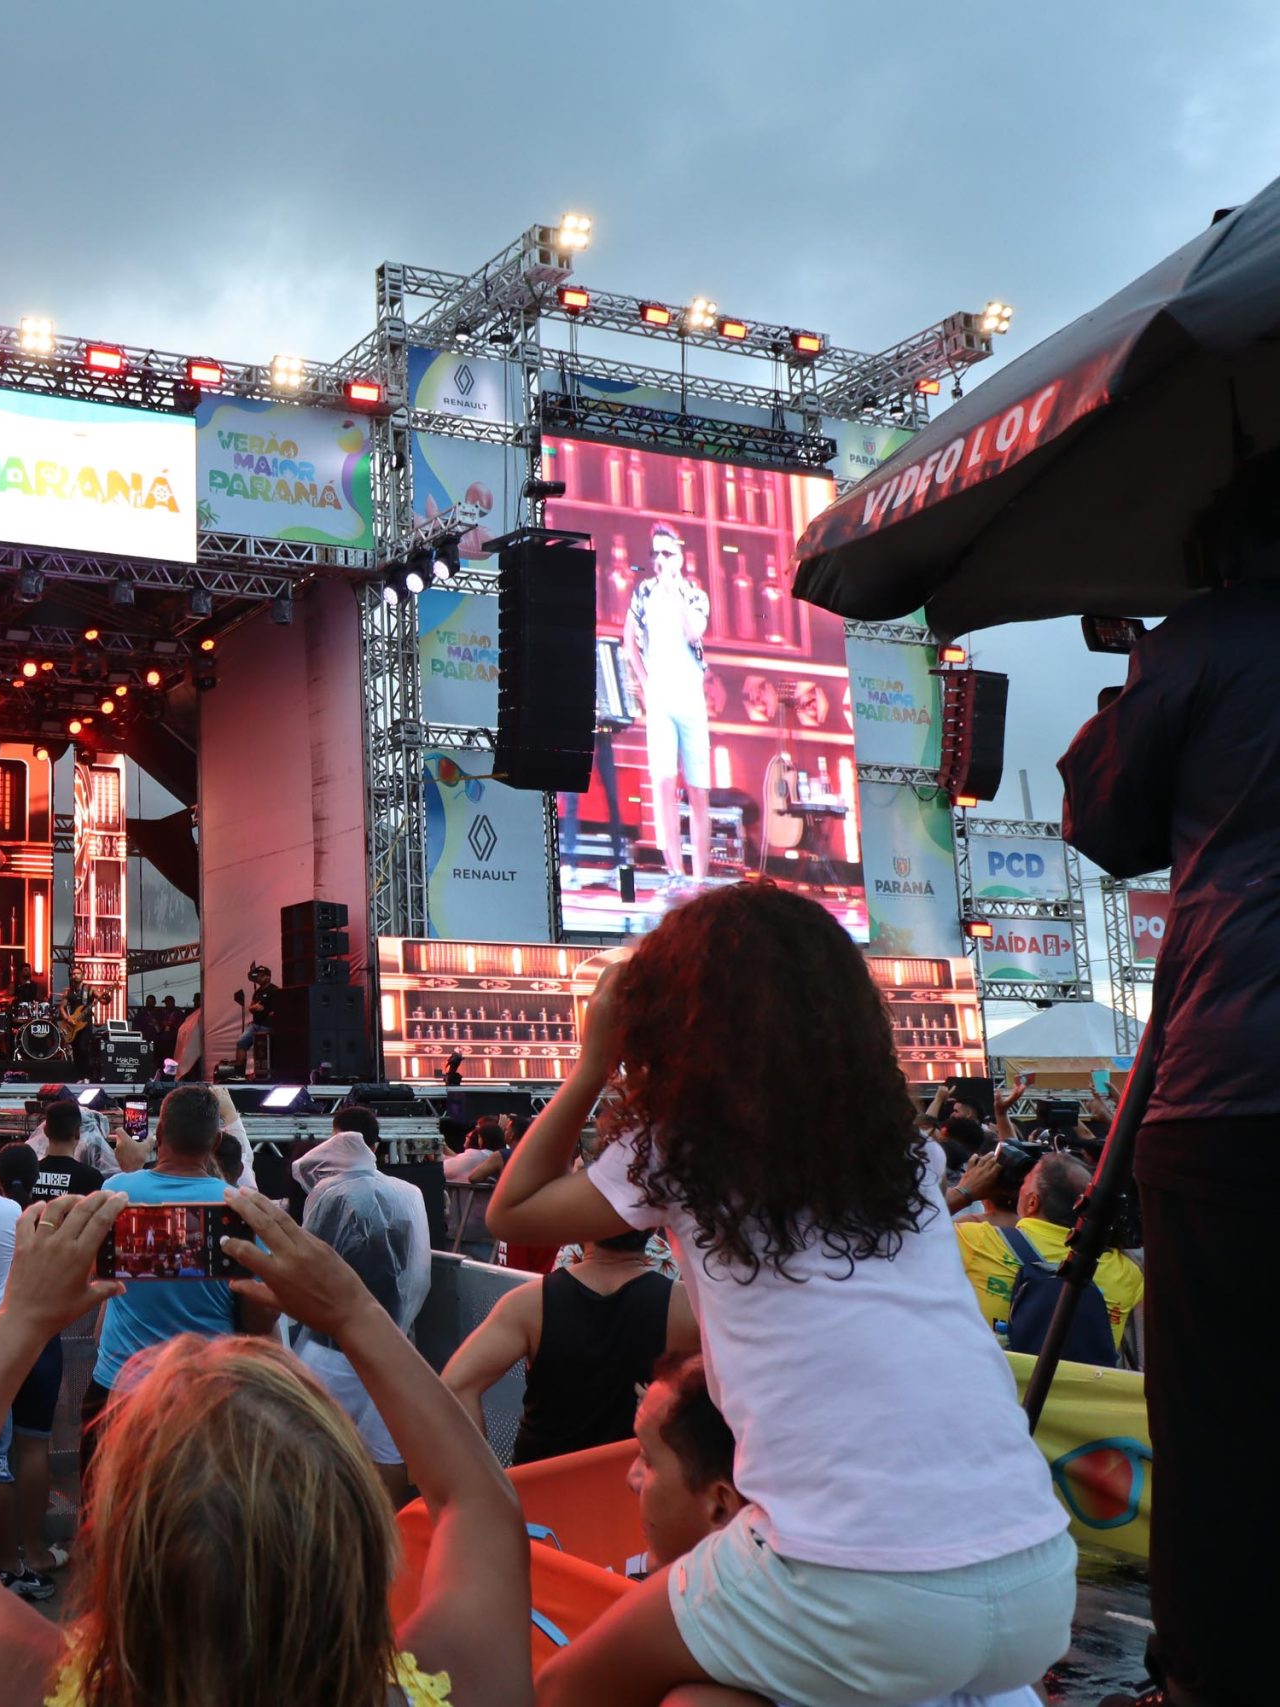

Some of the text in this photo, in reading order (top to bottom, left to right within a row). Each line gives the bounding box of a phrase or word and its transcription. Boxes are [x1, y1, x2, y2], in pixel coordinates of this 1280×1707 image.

[443, 397, 488, 410] RENAULT
[217, 430, 299, 458] VERÃO
[233, 452, 315, 481] MAIOR
[849, 453, 885, 466] PARAN
[209, 469, 342, 510] PARANÁ
[431, 658, 501, 682] PARAN
[855, 702, 931, 725] PARANÁ
[453, 868, 517, 881] RENAULT
[987, 851, 1045, 878] PCD
[875, 879, 935, 895] PARANÁ
[982, 931, 1042, 954] SAÍDA
